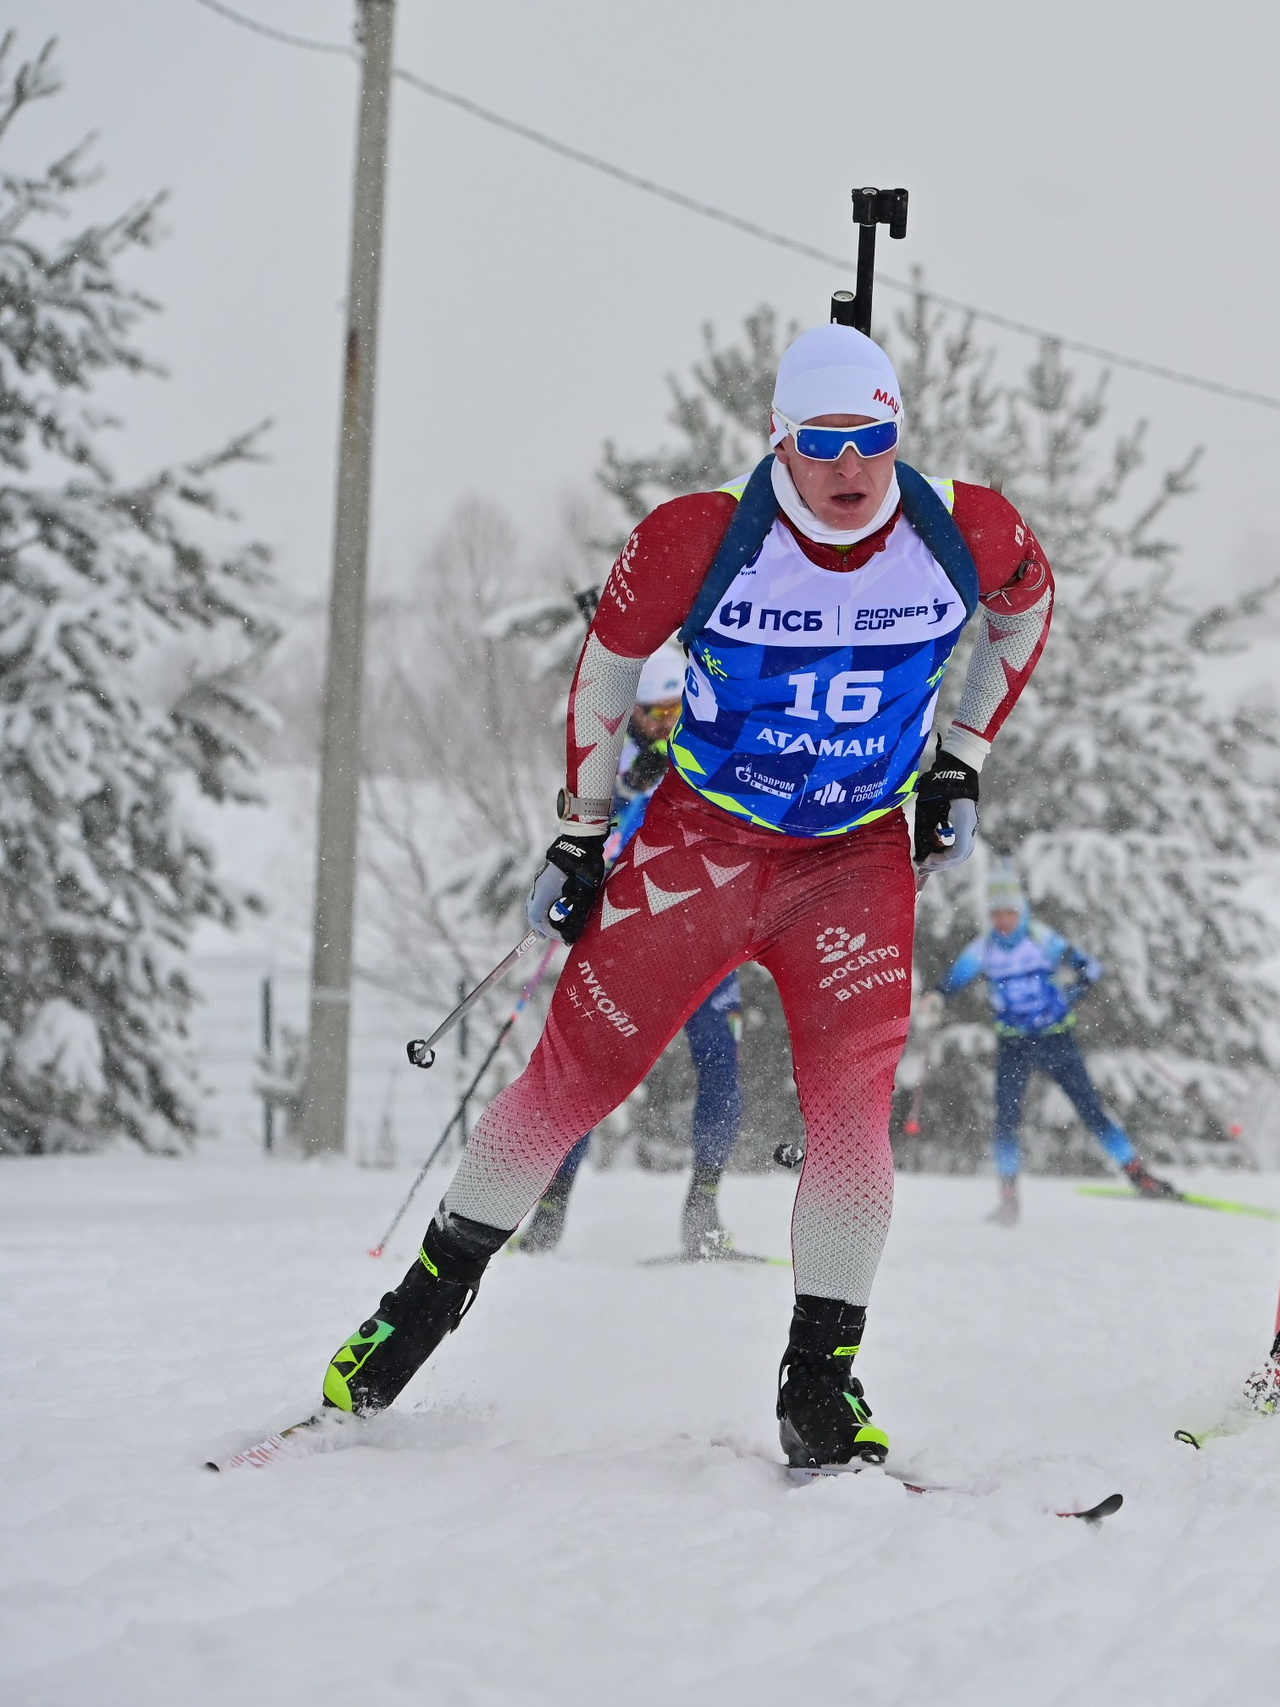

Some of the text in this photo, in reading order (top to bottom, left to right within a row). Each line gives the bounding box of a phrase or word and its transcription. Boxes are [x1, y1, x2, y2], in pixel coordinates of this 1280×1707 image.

[614, 562, 635, 602] АГРО
[758, 608, 823, 632] ПСБ
[854, 619, 896, 631] CUP
[856, 606, 929, 620] PIONER
[784, 670, 885, 723] 16
[756, 727, 886, 757] АТАМАН
[753, 771, 796, 792] ГАЗПРОМ
[853, 776, 889, 794] РОДНЫЕ
[850, 787, 883, 803] ГОРОДА
[819, 945, 900, 989] ФОСАГРО
[577, 960, 639, 1038] ЛУКОЙЛ
